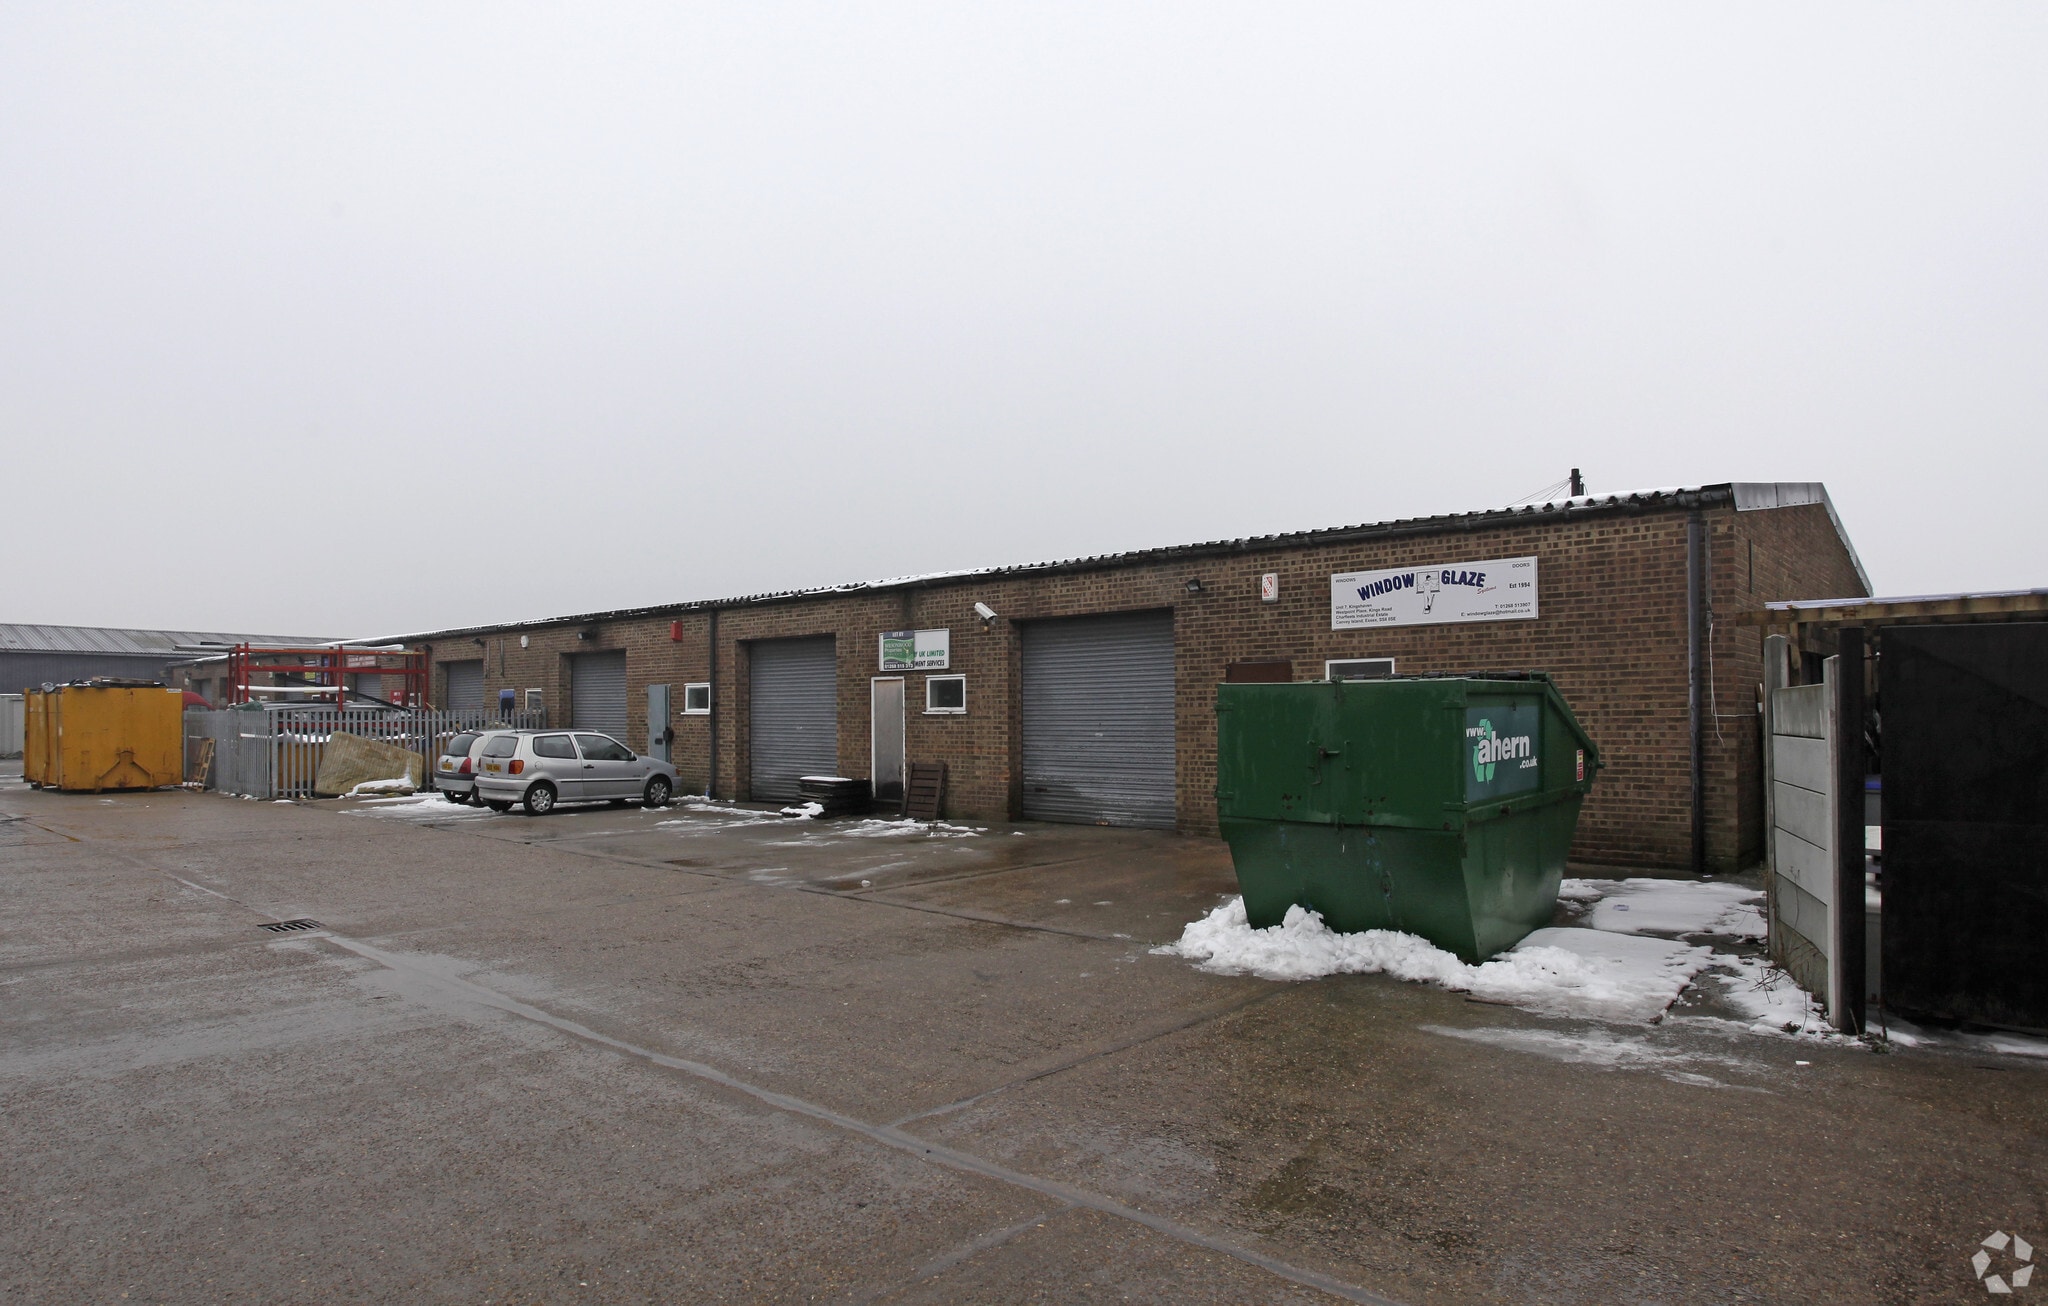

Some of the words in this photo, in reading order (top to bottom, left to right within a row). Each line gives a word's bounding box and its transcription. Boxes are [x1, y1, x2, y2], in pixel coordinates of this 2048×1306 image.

[1357, 573, 1414, 601] WINDOW
[1441, 570, 1486, 588] GLAZE
[1478, 731, 1530, 764] ahern
[1520, 756, 1537, 769] .co.uk
